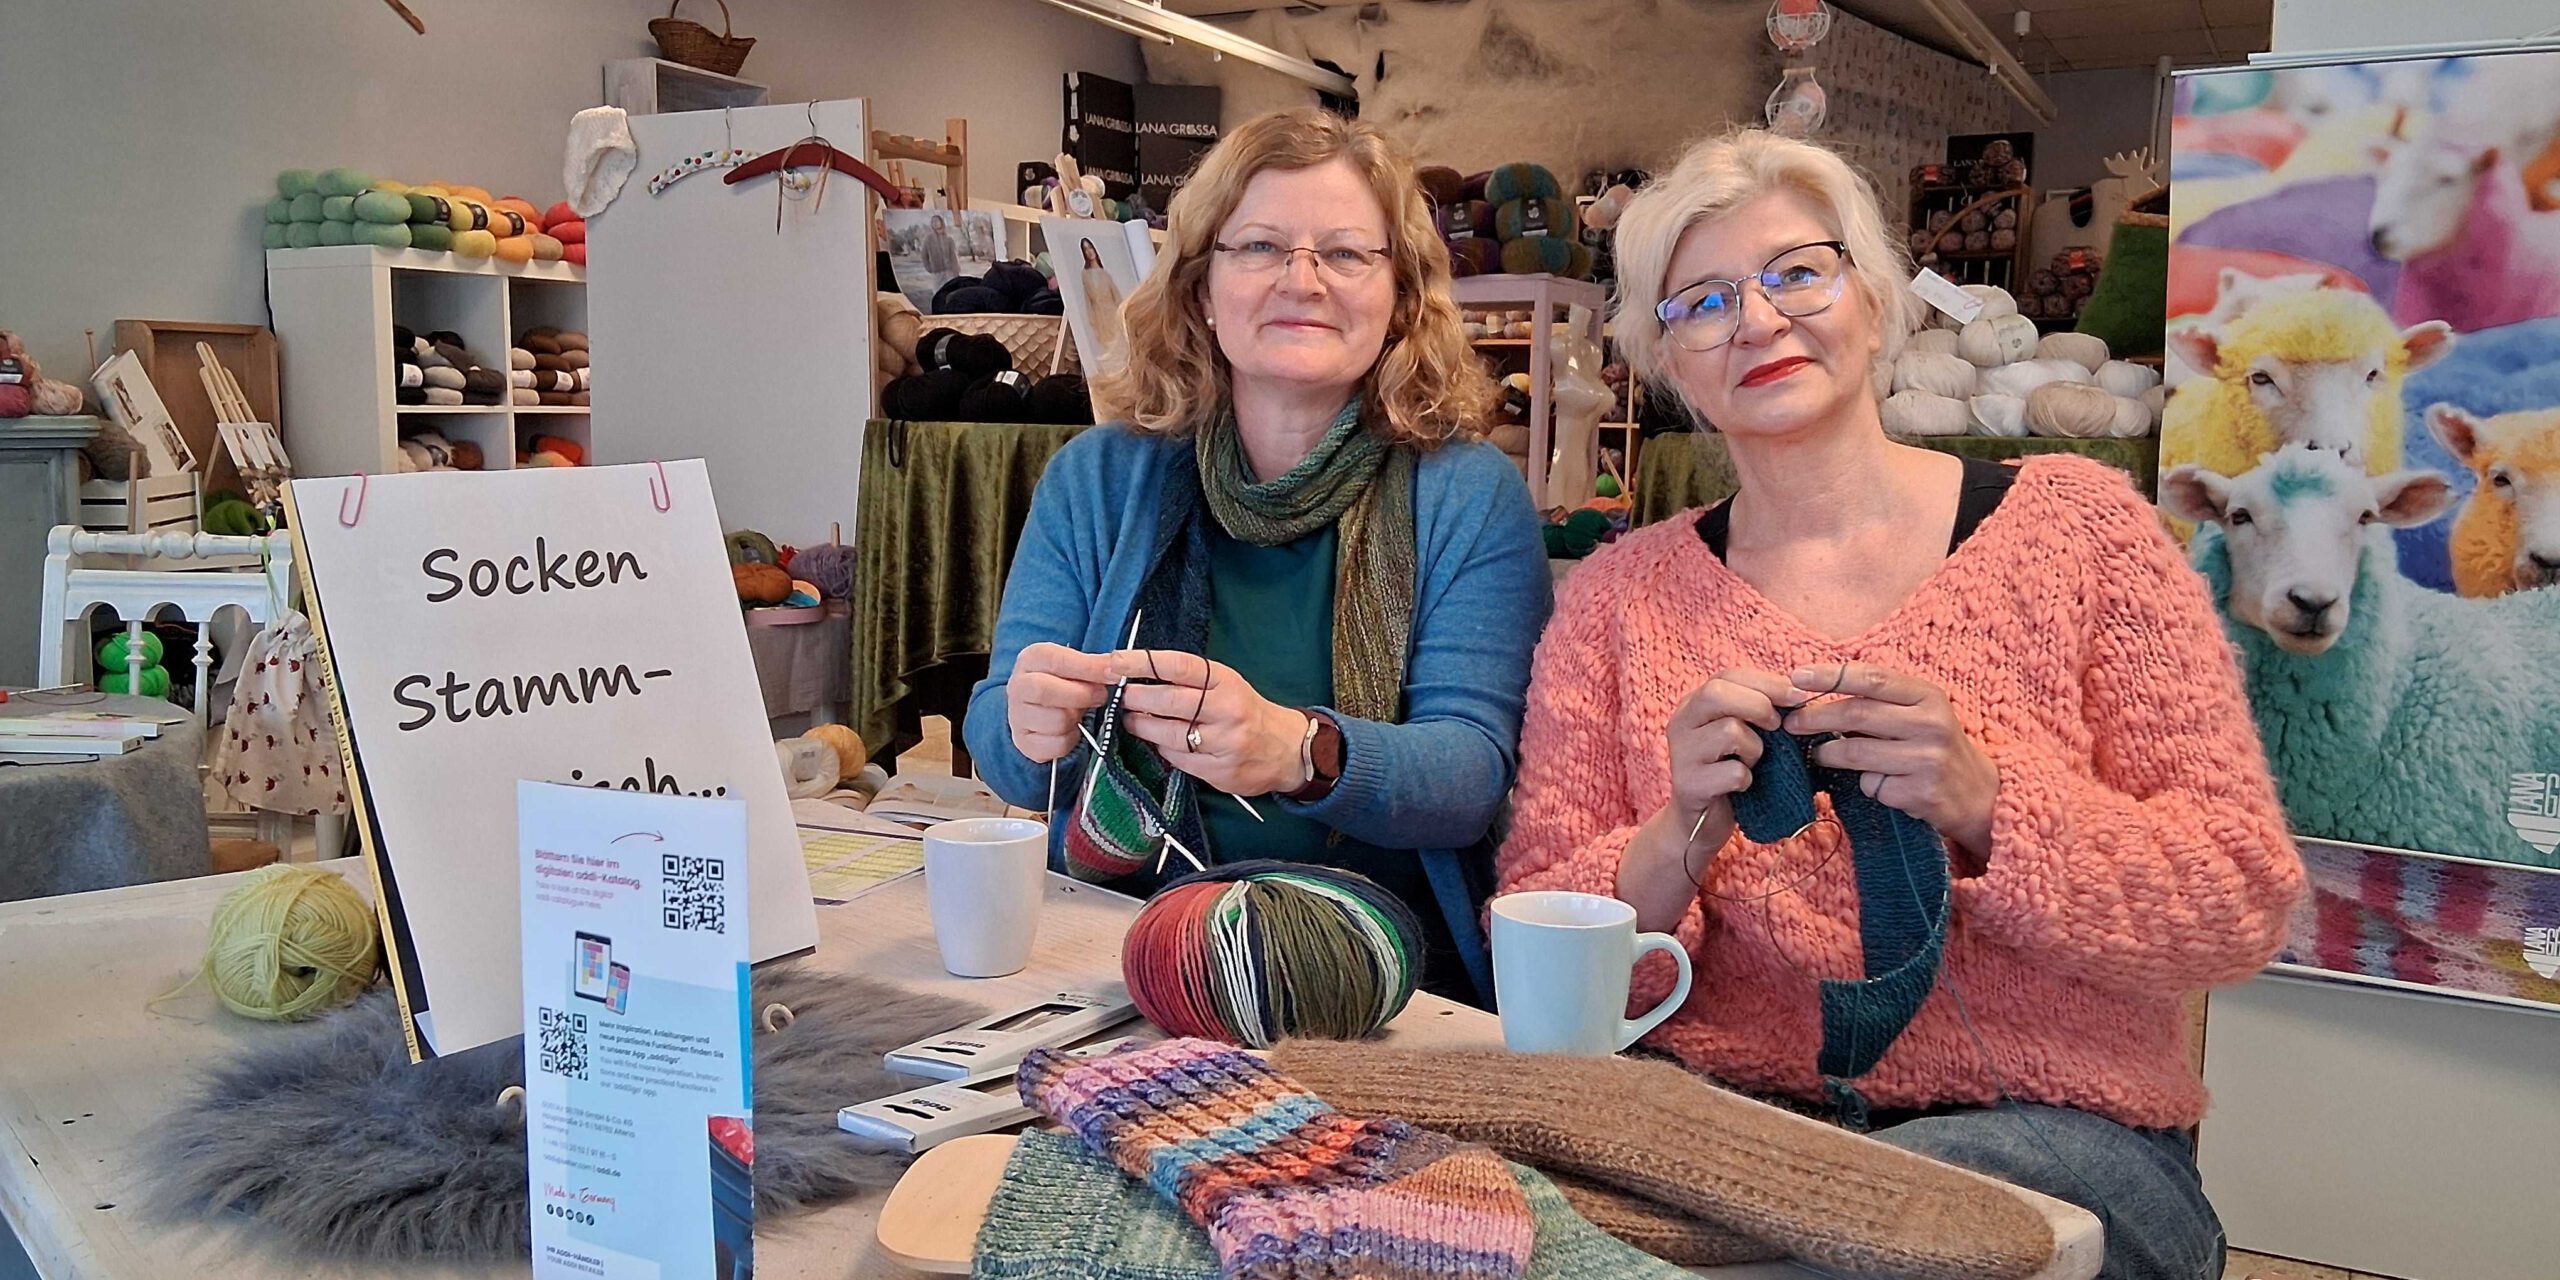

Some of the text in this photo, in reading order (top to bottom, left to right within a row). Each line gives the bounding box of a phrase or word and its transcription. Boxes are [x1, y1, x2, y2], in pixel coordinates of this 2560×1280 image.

[1085, 112, 1105, 128] LANA
[1135, 122, 1218, 136] LANA GROSSA
[1141, 173, 1171, 185] LANA
[422, 537, 647, 602] Socken
[394, 664, 672, 731] Stamm-
